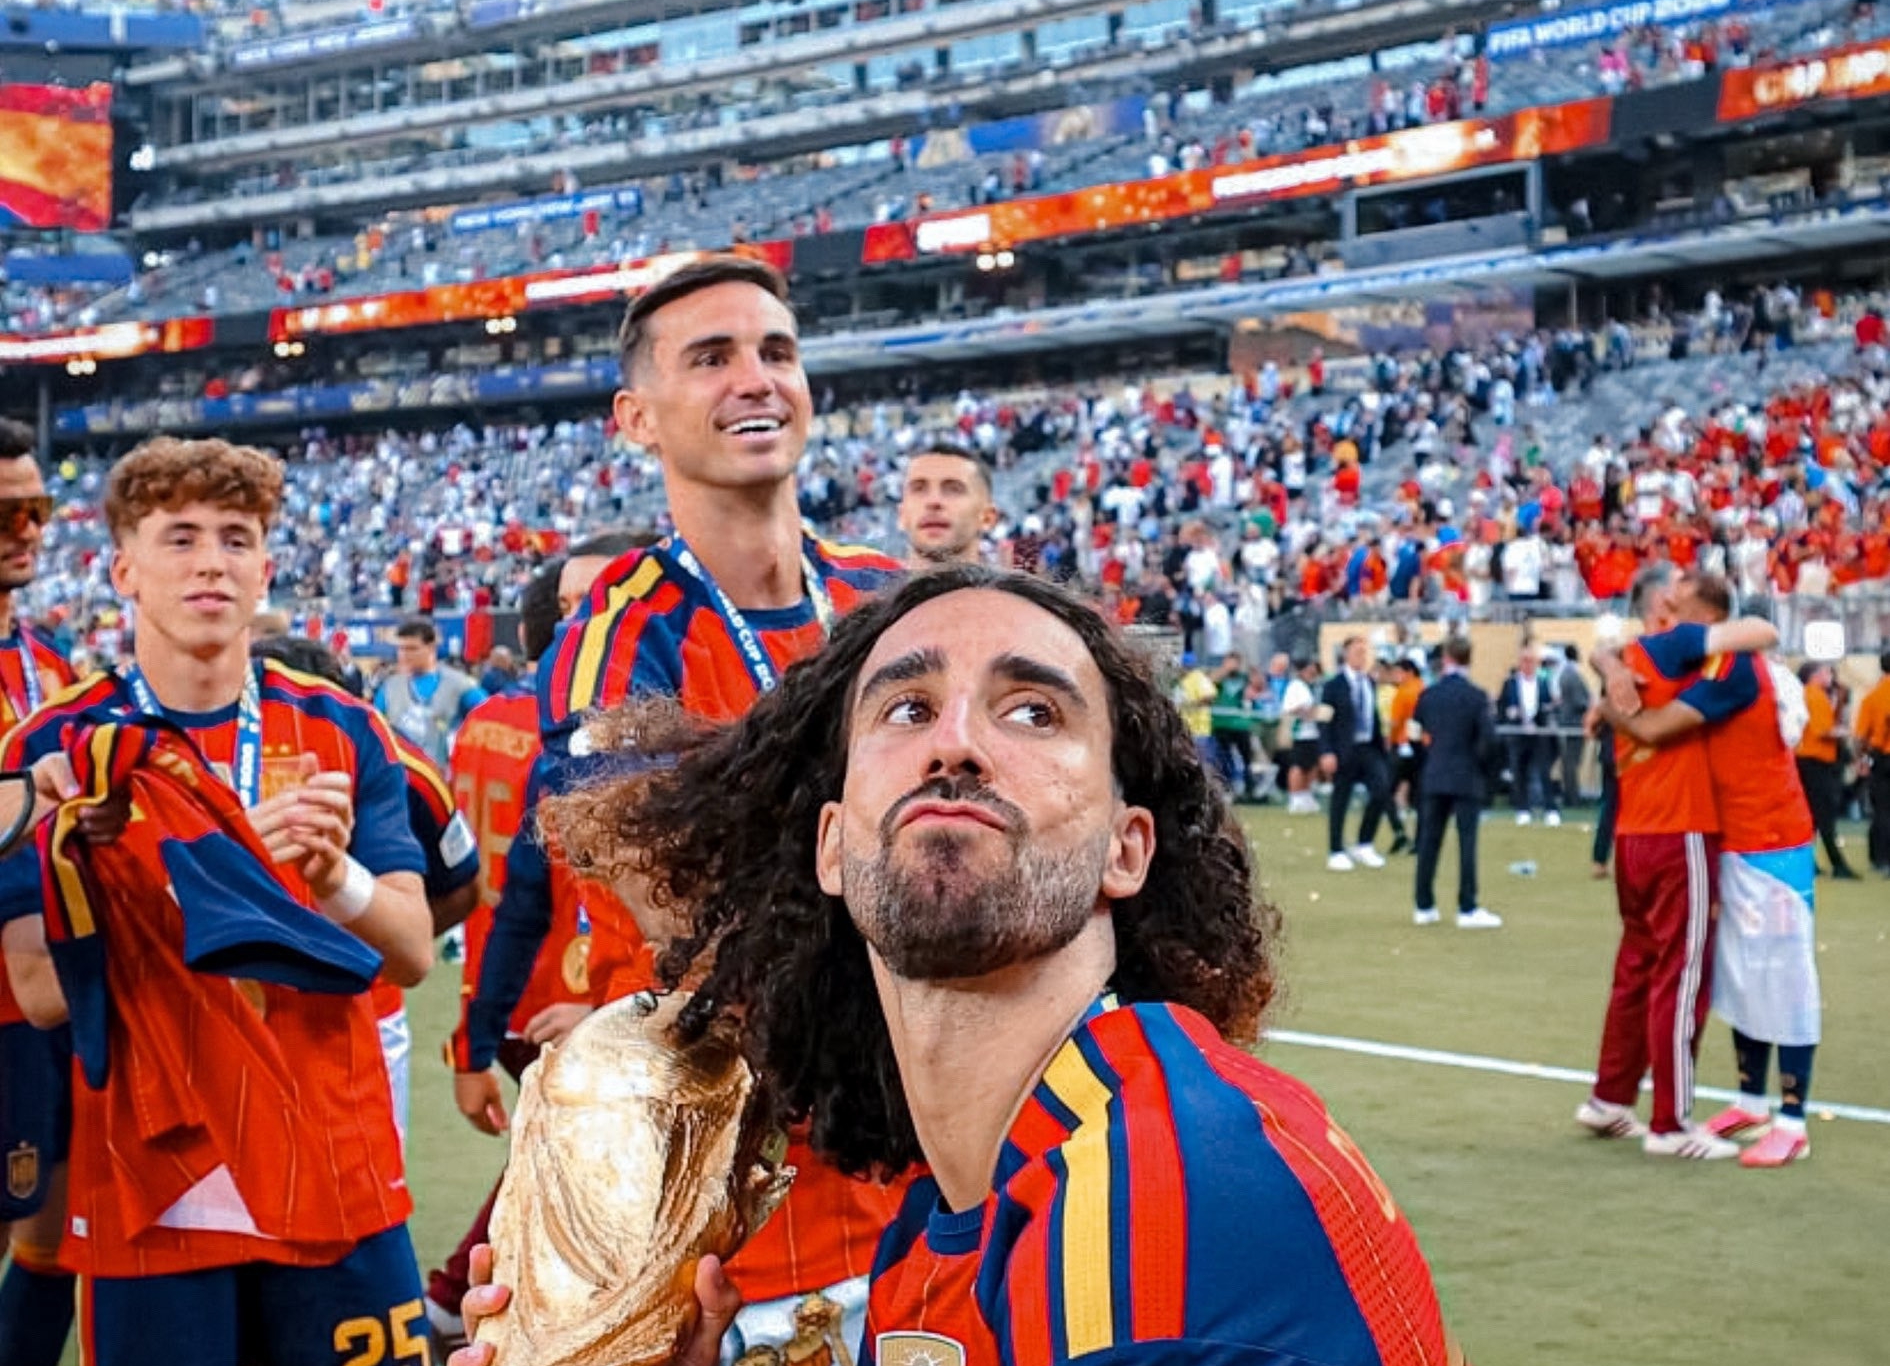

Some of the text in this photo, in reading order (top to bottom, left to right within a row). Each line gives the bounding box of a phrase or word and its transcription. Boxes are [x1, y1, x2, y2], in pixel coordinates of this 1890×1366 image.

[1489, 26, 1531, 52] FIFA
[1534, 10, 1607, 41] WORLD
[1609, 1, 1650, 29] CUP
[738, 628, 762, 662] CUP
